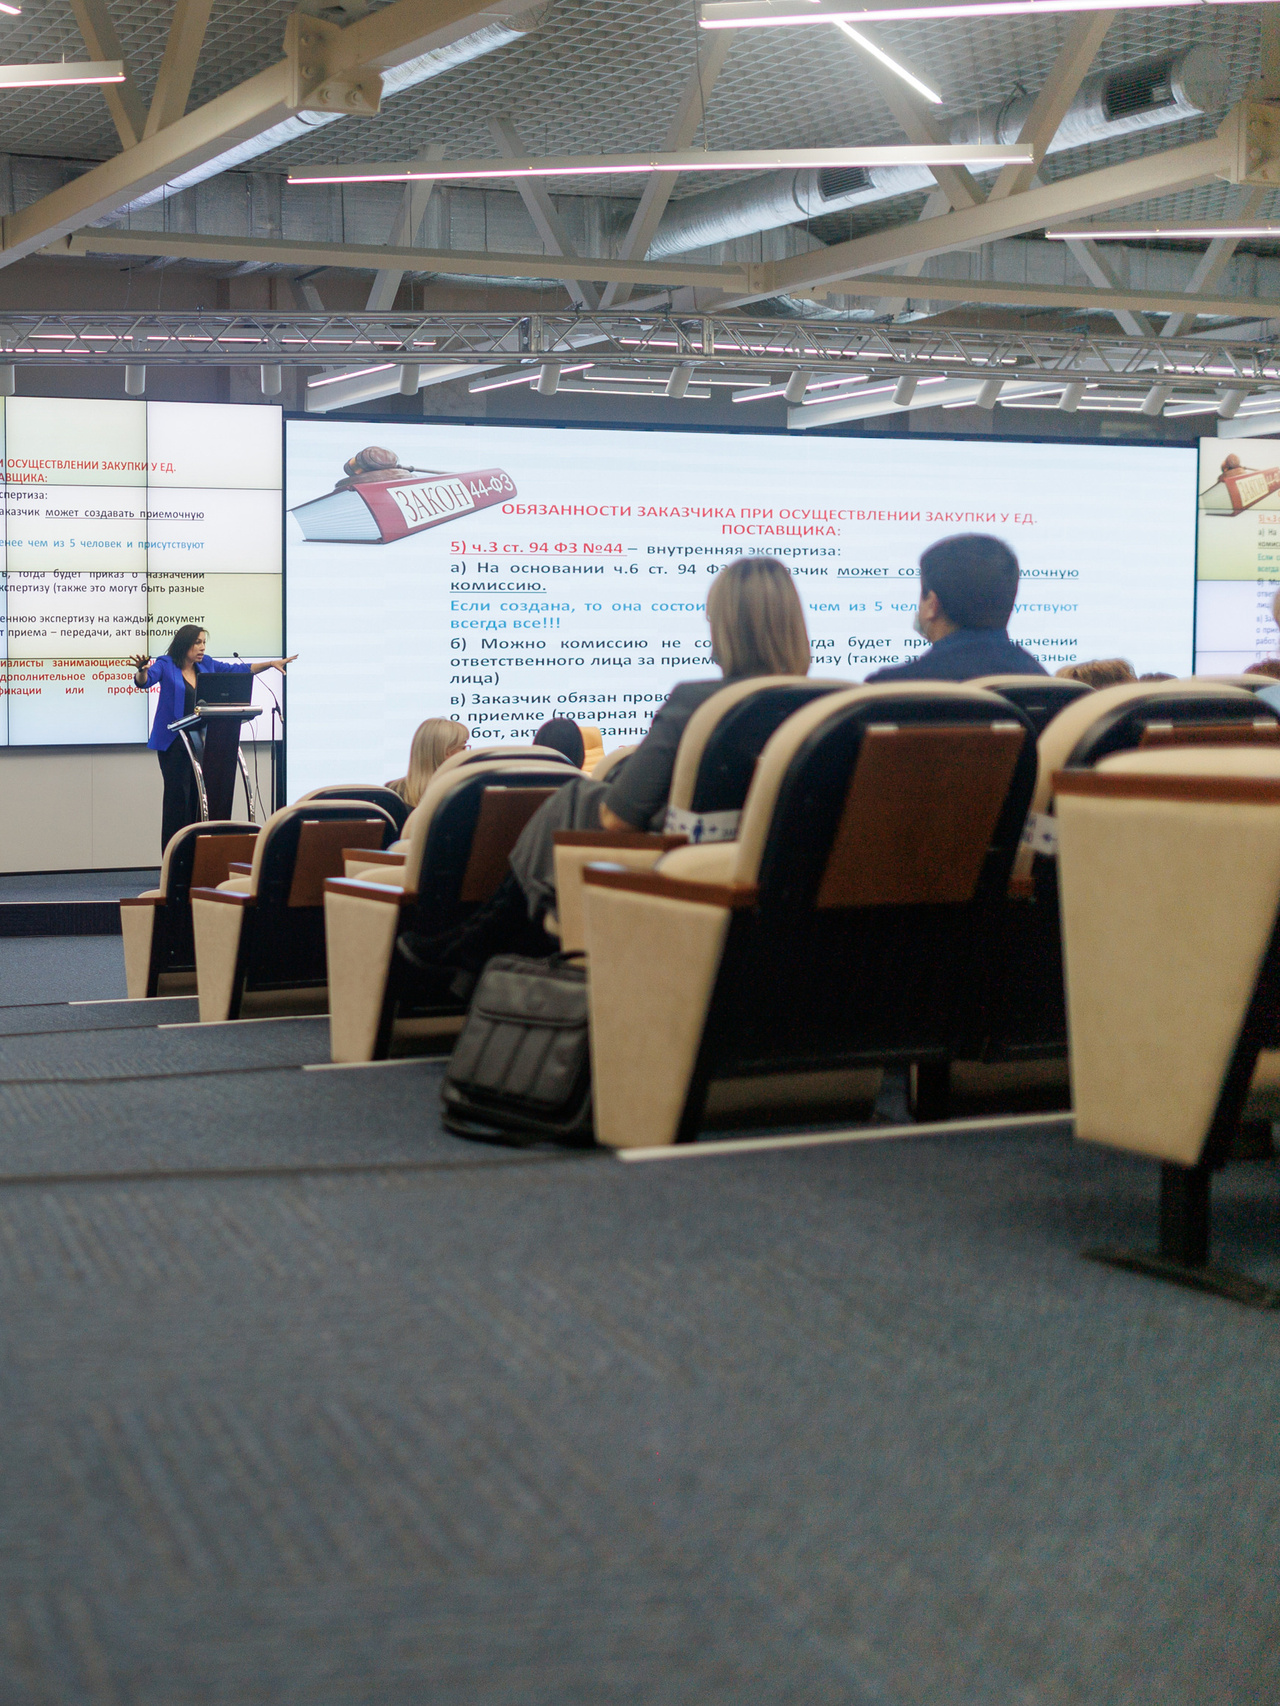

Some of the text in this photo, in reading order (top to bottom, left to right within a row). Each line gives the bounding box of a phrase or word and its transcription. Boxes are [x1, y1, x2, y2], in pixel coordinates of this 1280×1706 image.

[7, 459, 98, 470] ОСУЩЕСТВЛЕНИИ
[101, 461, 147, 471] ЗАКУПКИ
[160, 463, 176, 473] ЕД.
[395, 473, 514, 522] ЗАКОН 44-ФЗ
[45, 509, 79, 517] может
[84, 510, 134, 520] создавать
[139, 511, 204, 521] приемочную
[502, 503, 1038, 526] ОБЯЗАННОСТИ ЗАКАЗЧИКА ПРИ ОСУЩЕСТВЛЕНИИ ЗАКУПКИ ЕД.
[721, 524, 841, 538] ПОСТАВЩИКА:
[28, 540, 48, 548] чем
[53, 540, 65, 548] из
[80, 540, 122, 548] человек
[138, 541, 204, 550] присутствуют
[450, 541, 841, 558] 5) ч.3 ст. 94 ФЗ №44 внутренняя экспертиза:
[53, 569, 81, 580] будет
[450, 562, 466, 575] а)
[477, 562, 499, 574] На
[510, 564, 604, 574] основании
[614, 564, 639, 575] ч.6
[648, 565, 668, 575] ст.
[678, 564, 697, 575] 94
[837, 567, 889, 577] может
[53, 583, 87, 594] (также
[109, 585, 138, 594] могут
[140, 581, 165, 593] быть
[168, 585, 205, 594] разные
[450, 580, 546, 592] комиссию.
[450, 600, 1078, 615] Если создана, то она состои чем из утствуют
[39, 615, 95, 624] экспертизу
[113, 613, 154, 624] каждый
[156, 615, 205, 625] документ
[450, 617, 561, 631] всегда все!!!
[8, 629, 47, 638] приема
[60, 629, 112, 638] передачи,
[115, 629, 131, 637] акт
[450, 638, 467, 651] б)
[481, 638, 546, 649] Можно
[560, 639, 648, 649] комиссию
[662, 639, 681, 648] не
[848, 636, 891, 651] будет
[52, 660, 131, 668] занимающиеся
[450, 656, 585, 667] ответственного
[590, 656, 632, 667] лица
[637, 656, 655, 665] за
[847, 652, 899, 665] (также
[0, 673, 86, 682] дополнительное
[450, 671, 500, 685] лица)
[450, 692, 617, 707] в) Заказчик обязан
[468, 711, 544, 723] приемке
[552, 709, 637, 720] (товарная
